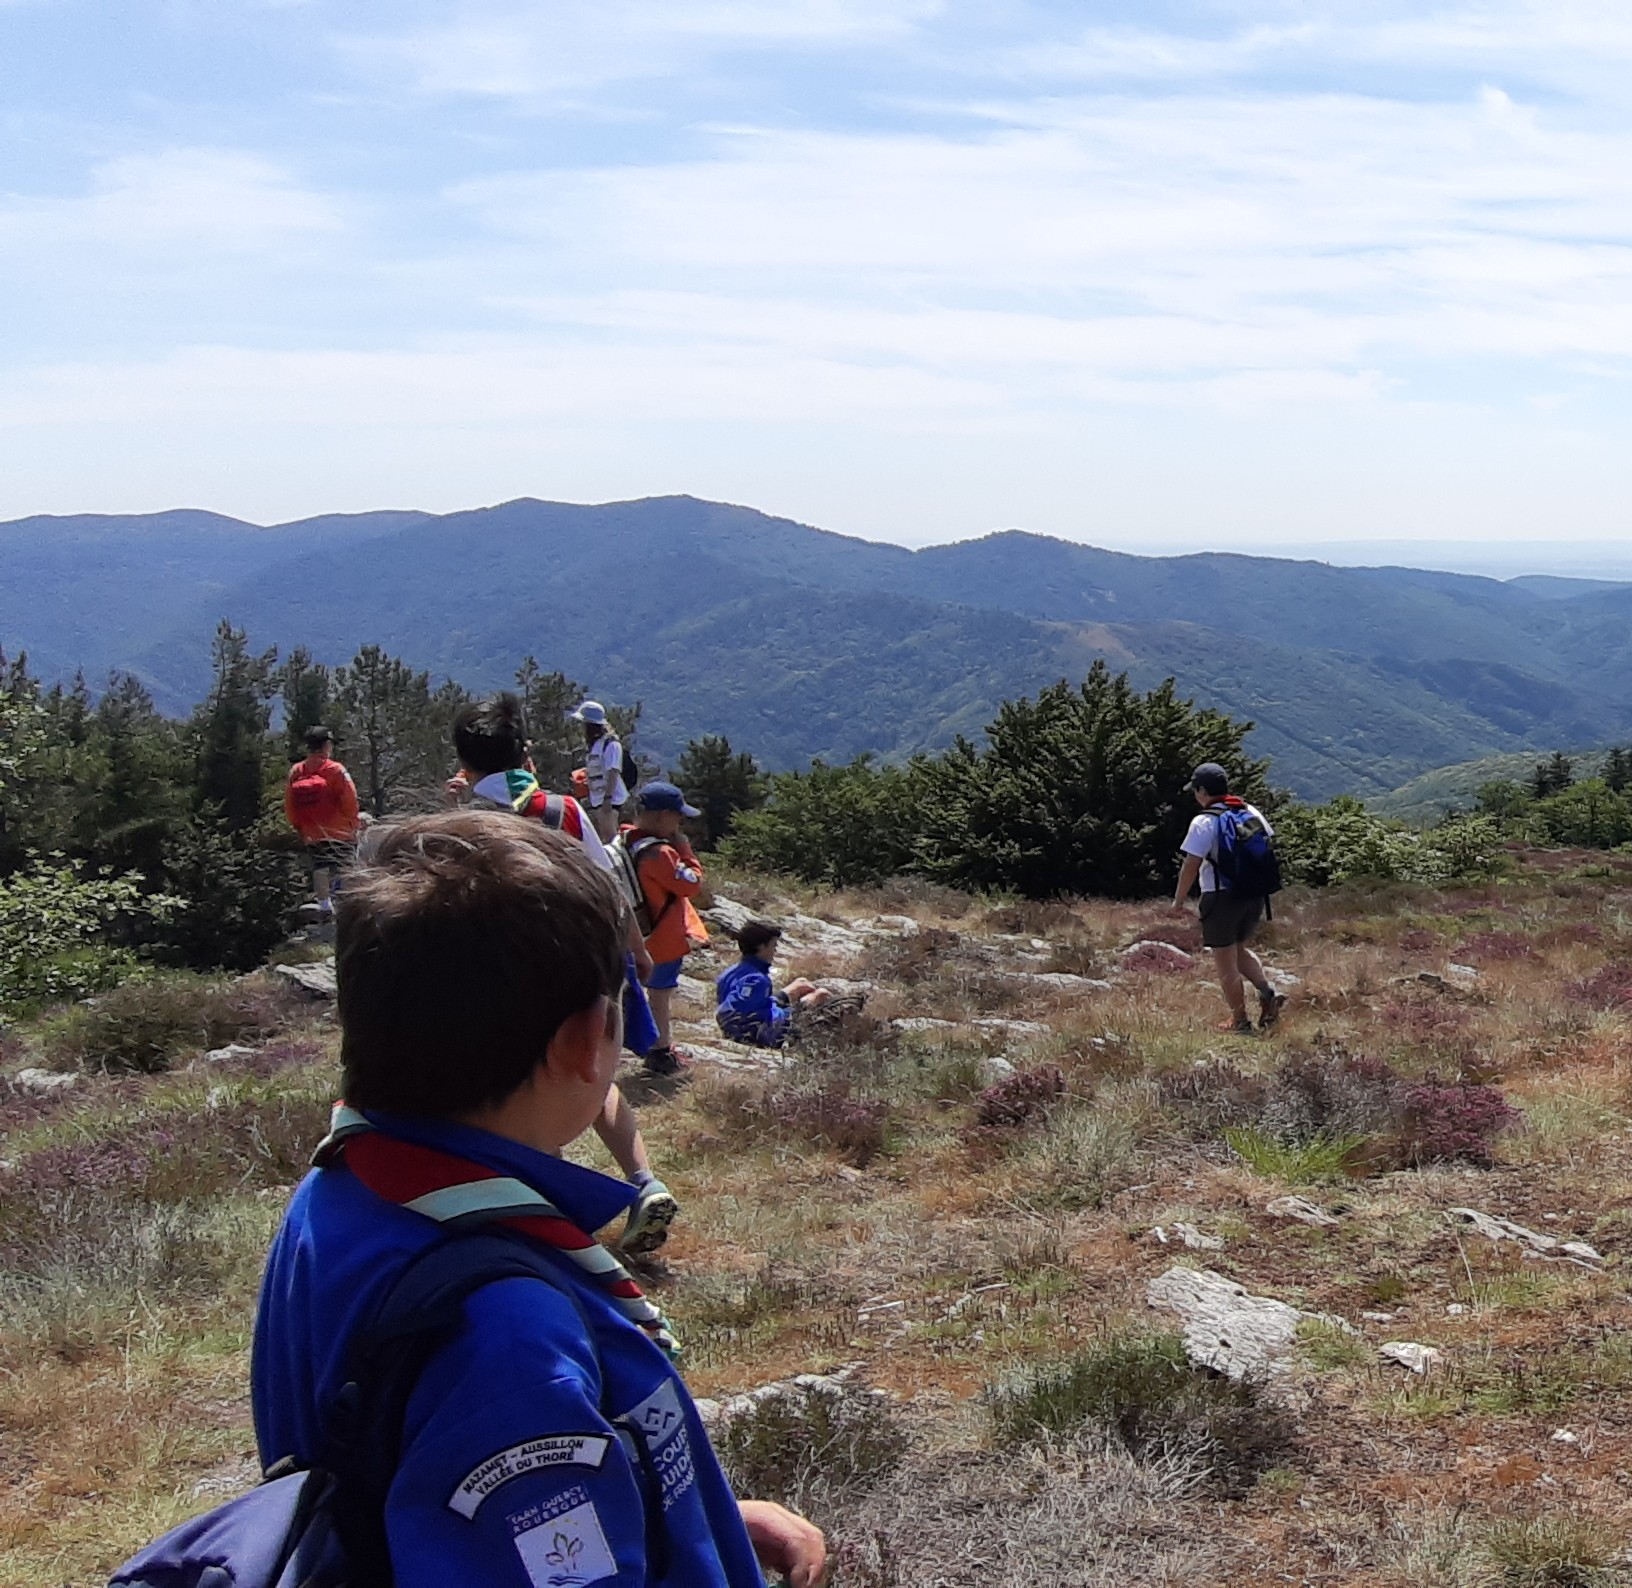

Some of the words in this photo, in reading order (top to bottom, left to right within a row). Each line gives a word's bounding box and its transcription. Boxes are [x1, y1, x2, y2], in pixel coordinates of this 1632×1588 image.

[462, 1455, 508, 1494] MAZAMET
[521, 1439, 584, 1457] AUSSILLON
[475, 1465, 515, 1495] VALLÉE
[517, 1458, 533, 1470] DU
[535, 1448, 575, 1465] THORÉ
